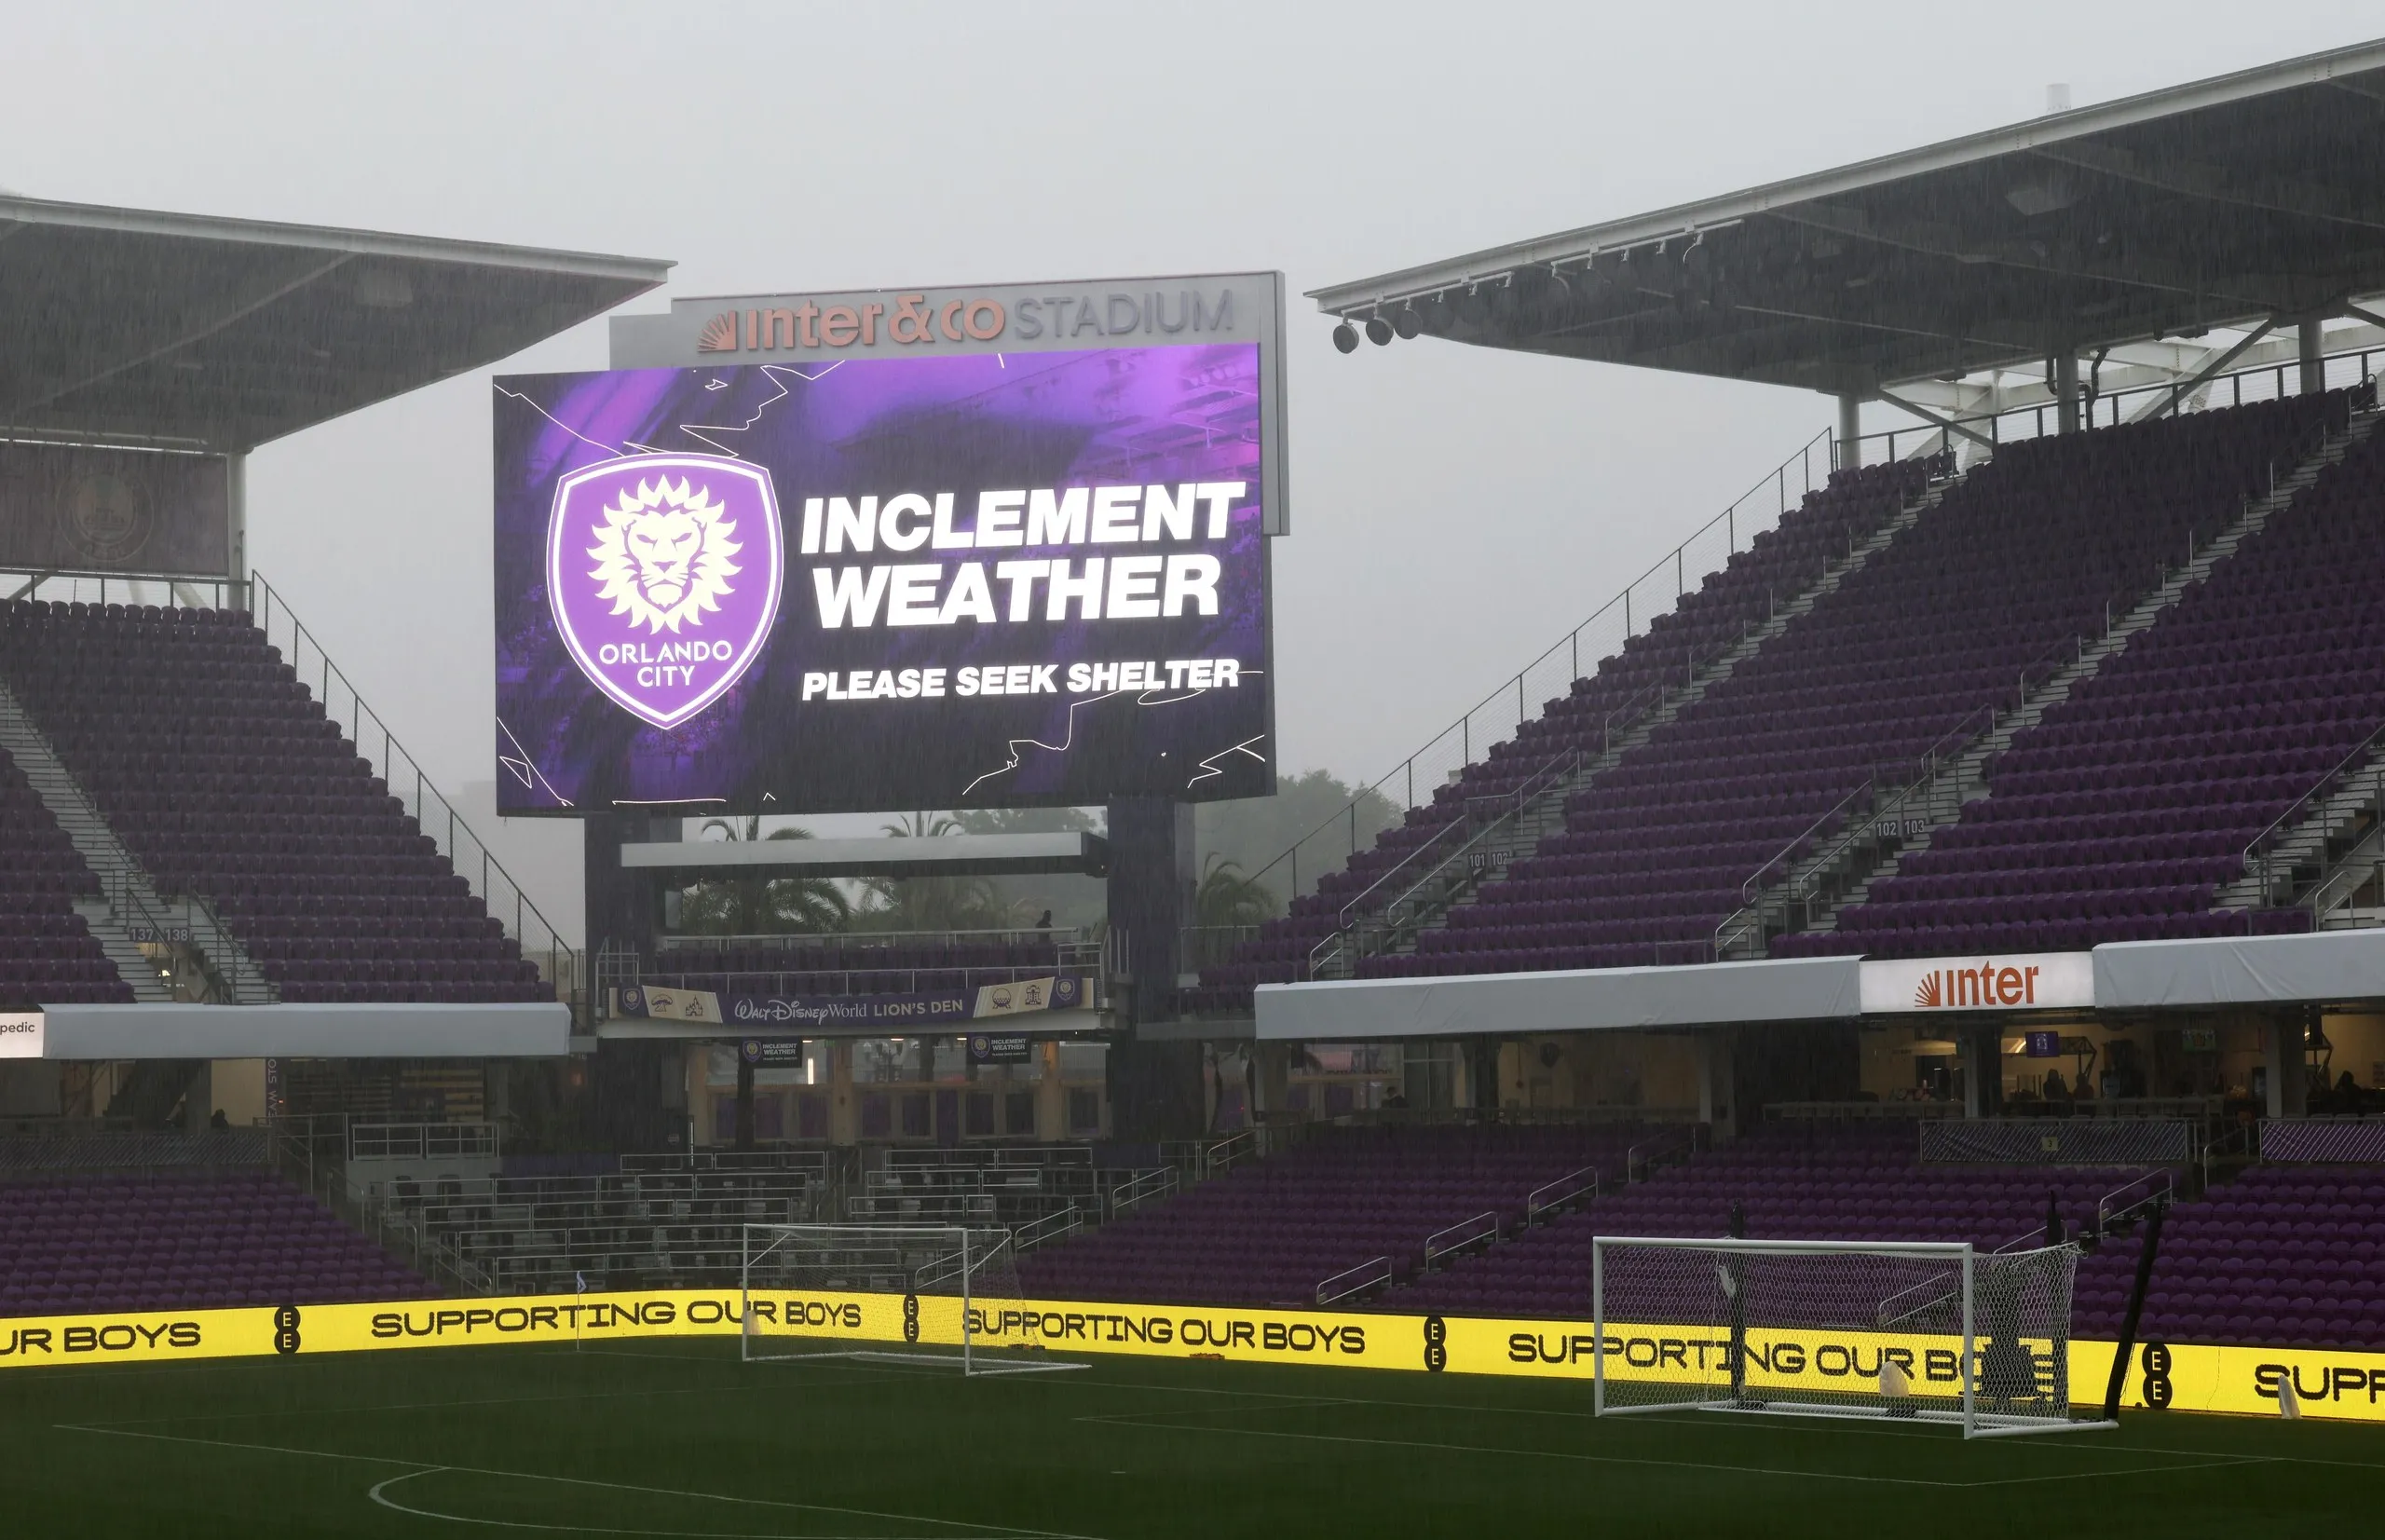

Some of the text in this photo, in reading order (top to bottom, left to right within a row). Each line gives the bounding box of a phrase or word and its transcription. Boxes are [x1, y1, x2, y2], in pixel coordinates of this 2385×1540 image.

[1015, 289, 1233, 340] STADIUM
[800, 482, 1247, 554] INCLEMENT
[812, 554, 1221, 629] WEATHER
[599, 640, 732, 665] ORLANDO
[636, 665, 696, 688] CITY
[802, 659, 1240, 701] PLEASE SEEK SHELTER
[1877, 822, 1897, 837] 102
[1905, 820, 1925, 835] 103
[1469, 854, 1485, 866] 101
[130, 928, 154, 941] 137
[165, 929, 188, 941] 138
[1946, 961, 2038, 1007] inter
[827, 1002, 867, 1018] World
[874, 1002, 926, 1017] LION'S
[932, 999, 963, 1014] DEN
[0, 1021, 35, 1035] pedic
[371, 1301, 862, 1338] SUPPORTING OUR BOYS
[962, 1308, 1366, 1355] SUPPORTING OUR BOYS
[63, 1322, 200, 1353] BOYS
[1507, 1333, 1806, 1374] SUPPORTING
[1816, 1344, 1916, 1380] OUR
